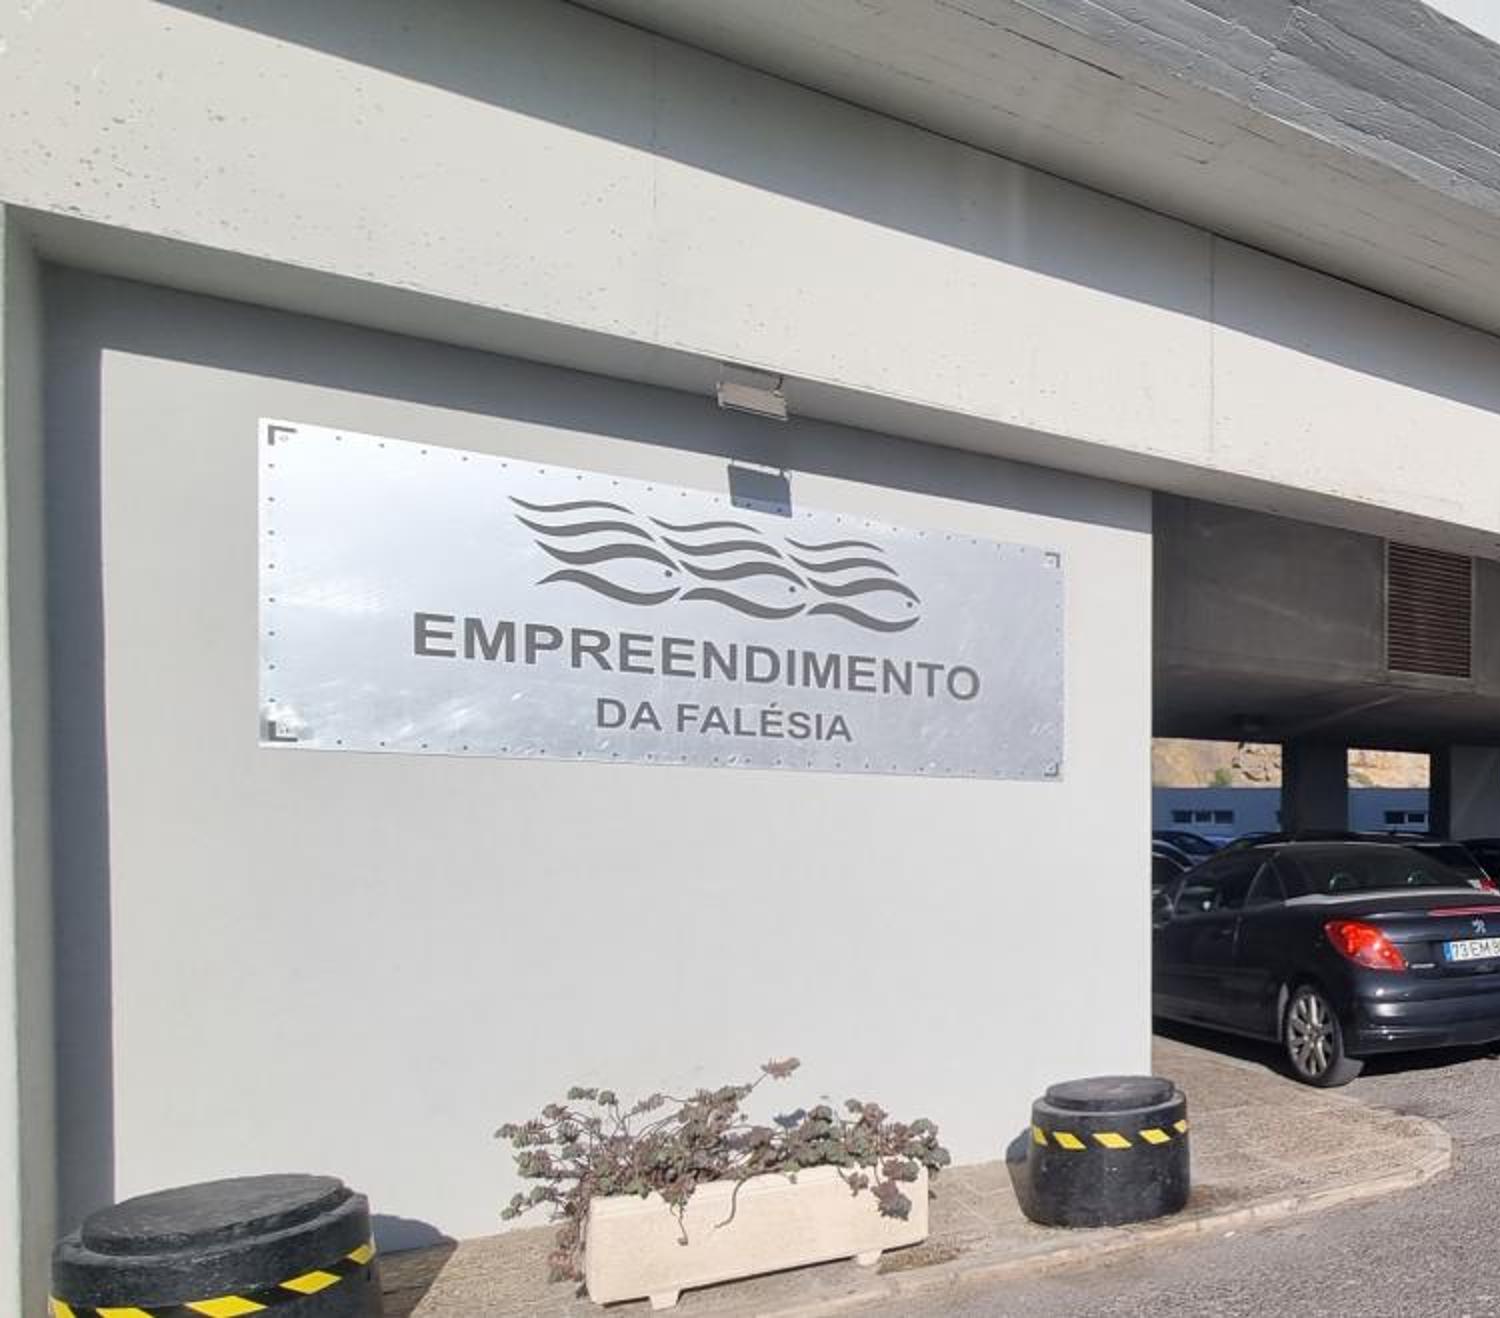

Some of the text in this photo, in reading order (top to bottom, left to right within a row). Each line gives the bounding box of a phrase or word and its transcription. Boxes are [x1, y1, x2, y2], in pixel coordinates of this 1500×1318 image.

[413, 612, 980, 701] EMPREENDIMENTO
[597, 698, 853, 743] DA FALÉSIA
